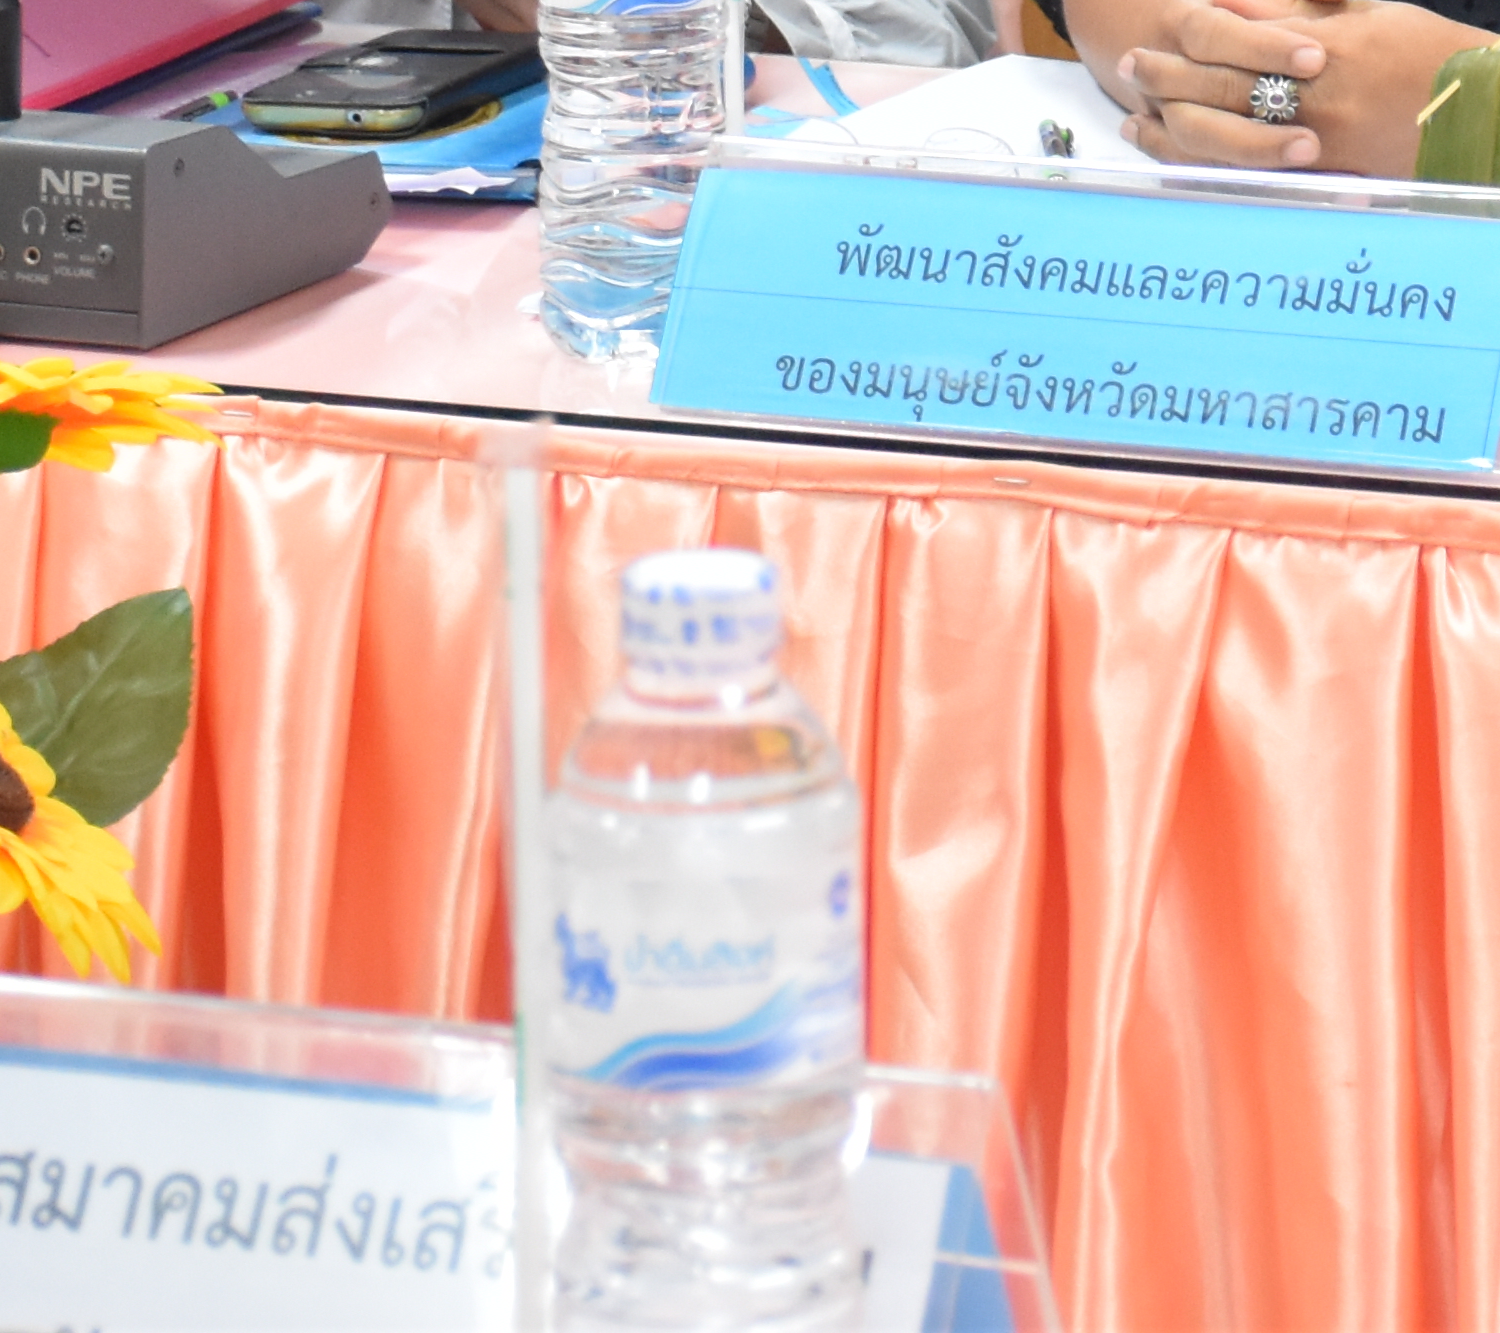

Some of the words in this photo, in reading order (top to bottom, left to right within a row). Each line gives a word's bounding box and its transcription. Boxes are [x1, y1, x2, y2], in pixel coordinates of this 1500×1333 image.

[40, 166, 132, 200] NPE
[835, 221, 1458, 323] พัฒนาสังคมและความมั่นคง
[774, 348, 1446, 445] ของมนุษย์จังหวัดมหาสารคาม
